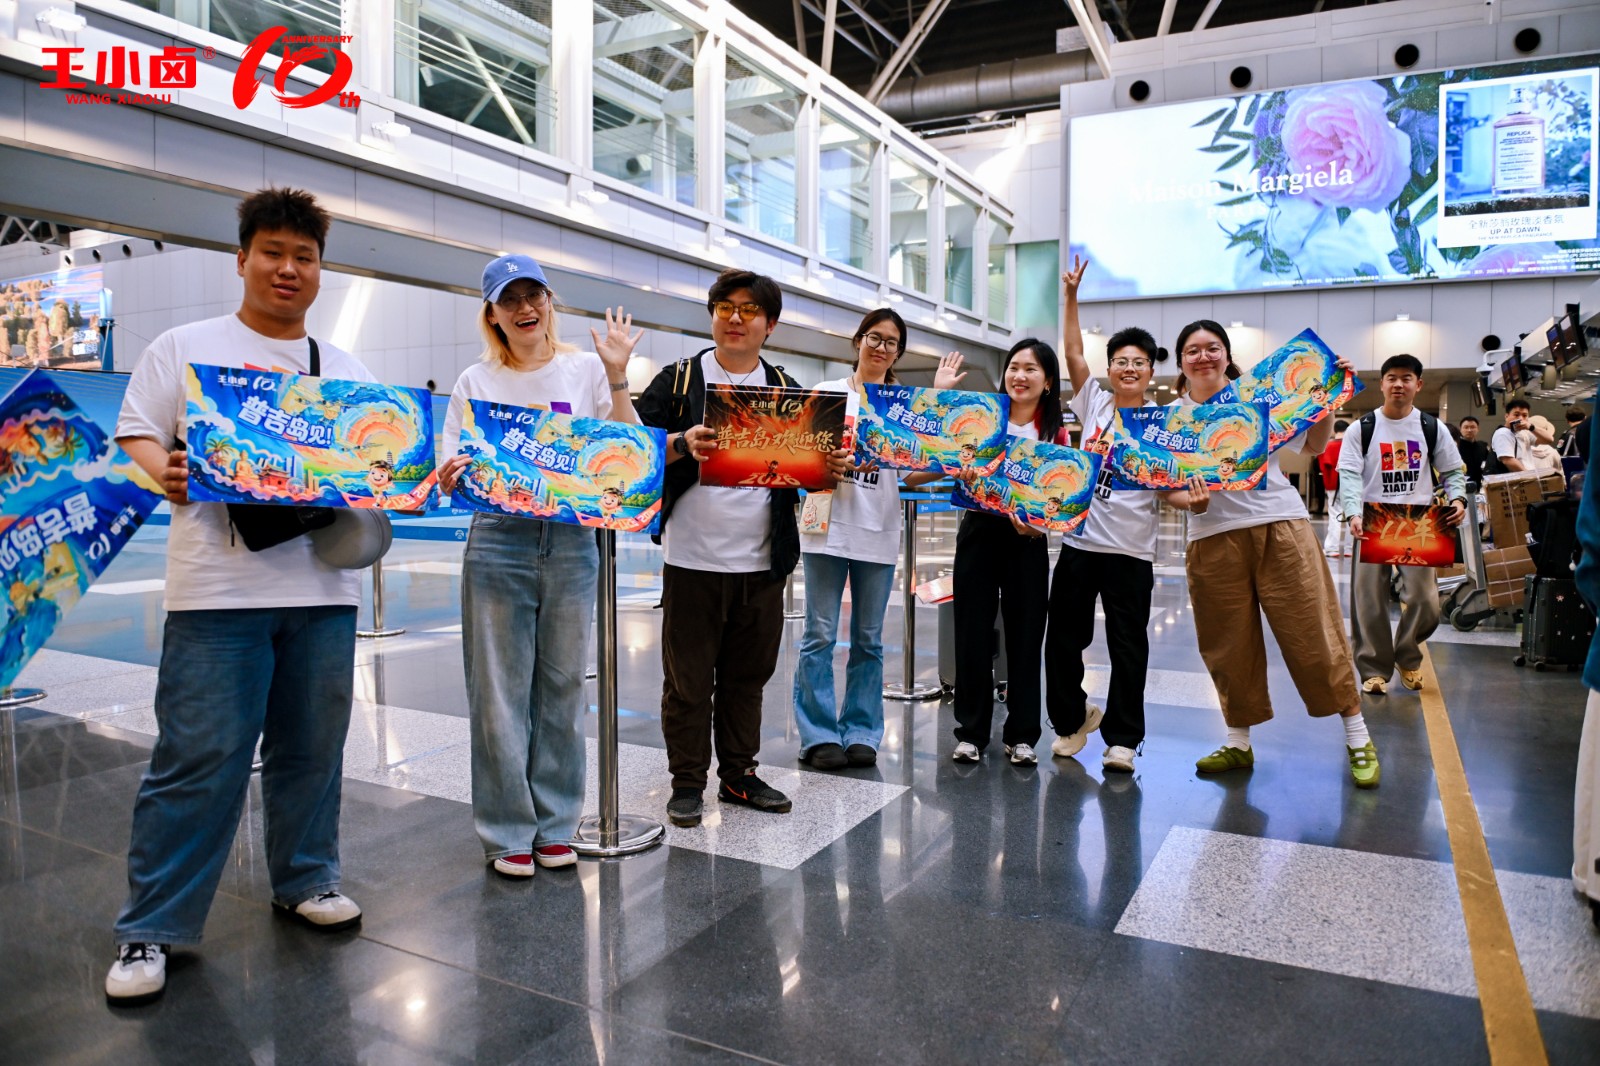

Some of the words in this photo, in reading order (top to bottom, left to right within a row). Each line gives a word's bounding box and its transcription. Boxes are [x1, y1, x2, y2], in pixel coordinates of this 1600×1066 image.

[1232, 161, 1354, 195] Margiela
[1516, 226, 1541, 234] DAWN
[506, 262, 519, 273] LA
[238, 395, 332, 445] 普吉岛见!
[886, 402, 941, 433] 普吉岛见!
[500, 427, 576, 472] 普吉岛见!
[717, 424, 836, 455] 普吉岛欢迎您
[1142, 423, 1198, 450] 普吉岛见!
[738, 472, 801, 485] 2026
[1003, 458, 1034, 483] 吉岛见!
[1382, 470, 1420, 483] WANG
[1383, 483, 1407, 493] XIAO
[0, 491, 98, 578] 普吉岛见
[1380, 513, 1436, 548] 11车
